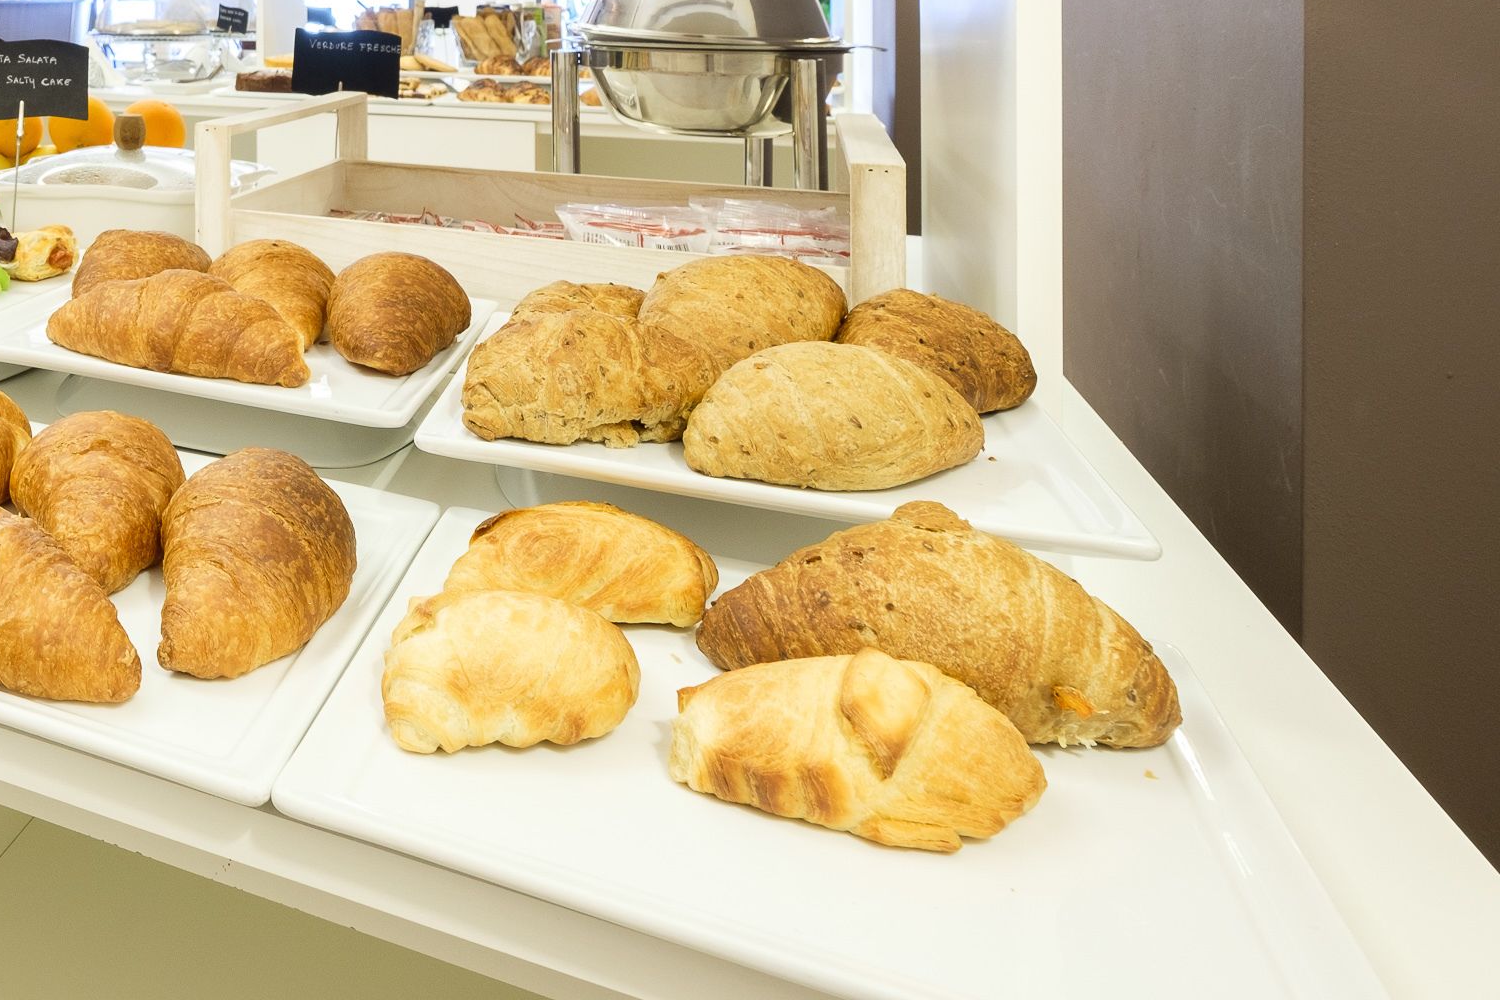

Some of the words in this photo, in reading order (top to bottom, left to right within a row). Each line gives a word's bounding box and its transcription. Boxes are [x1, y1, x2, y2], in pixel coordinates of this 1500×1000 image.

[17, 53, 57, 65] SALATA
[6, 75, 36, 89] SALTY
[41, 77, 72, 86] CAKE
